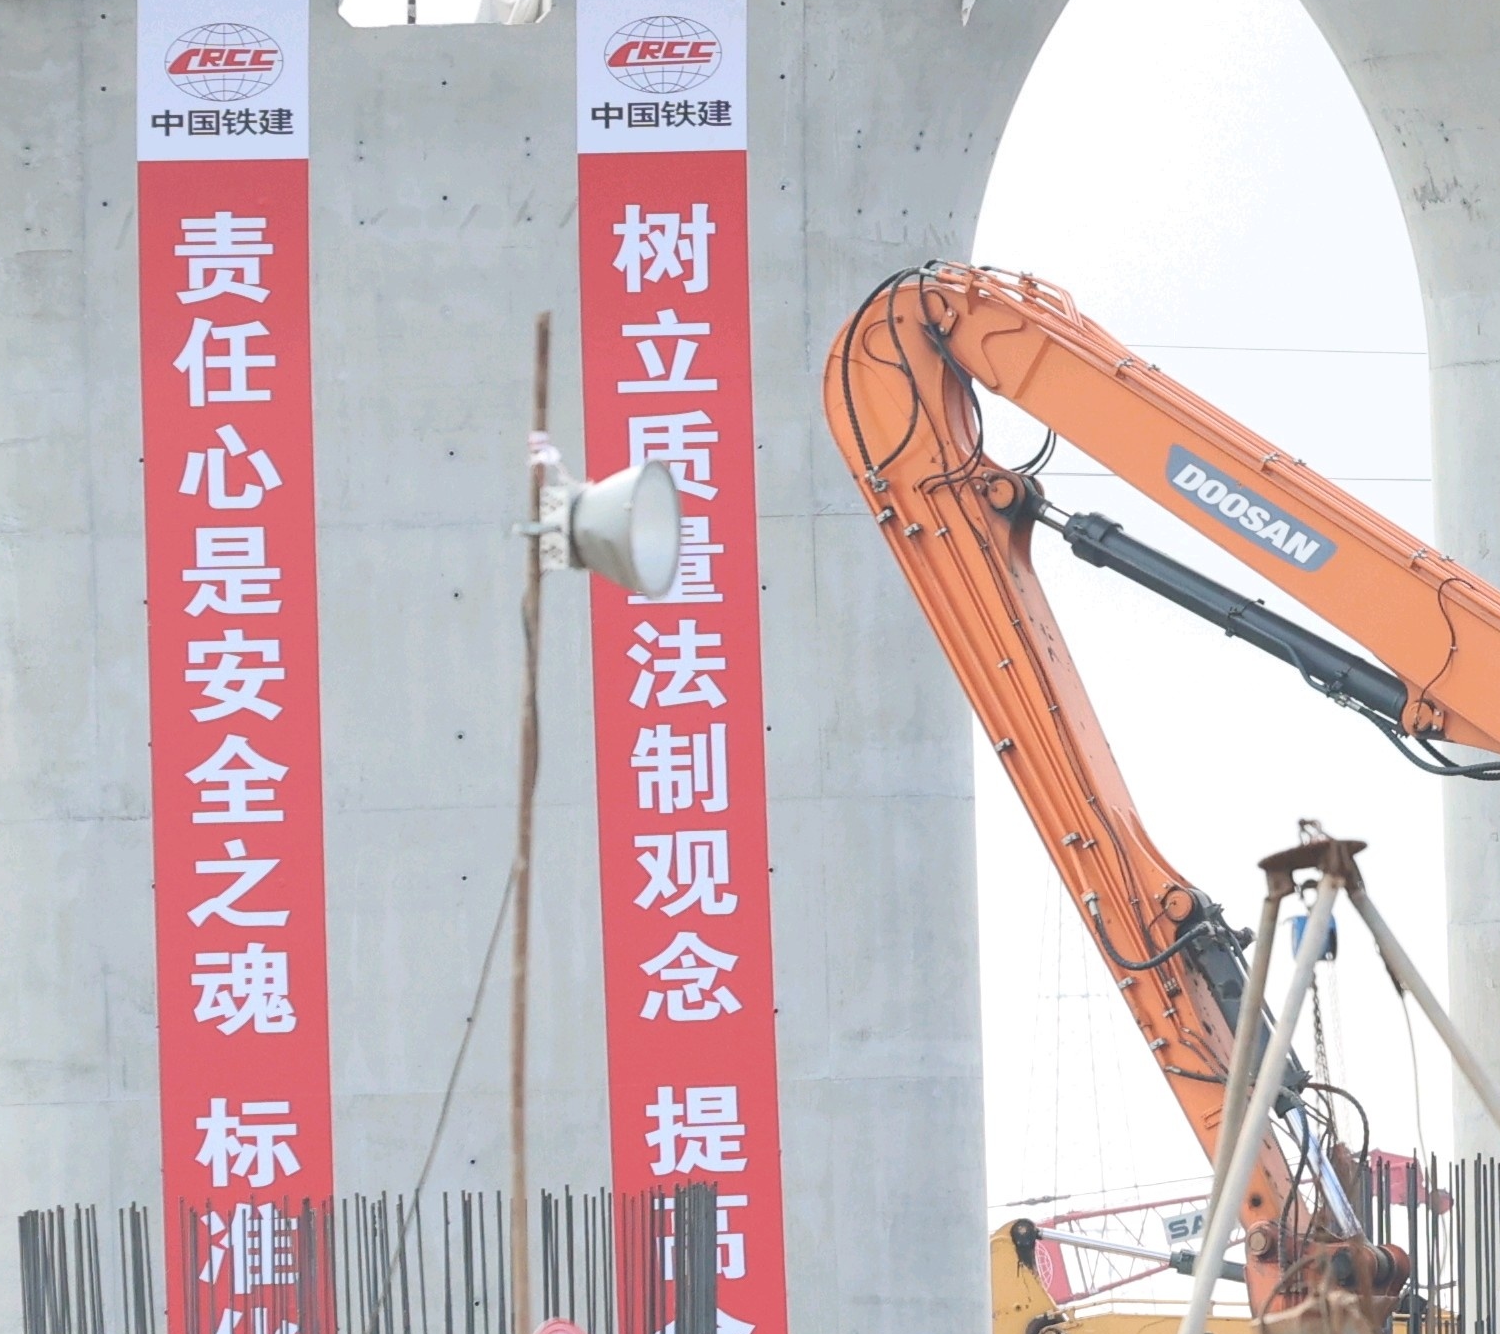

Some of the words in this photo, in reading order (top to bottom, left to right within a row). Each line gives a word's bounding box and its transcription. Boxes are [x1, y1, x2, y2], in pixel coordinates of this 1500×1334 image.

[151, 108, 294, 137] 中国铁建
[591, 100, 732, 129] 中国铁建
[1172, 463, 1320, 565] DOOSAN
[173, 211, 297, 1035] 责任心是安全之魂
